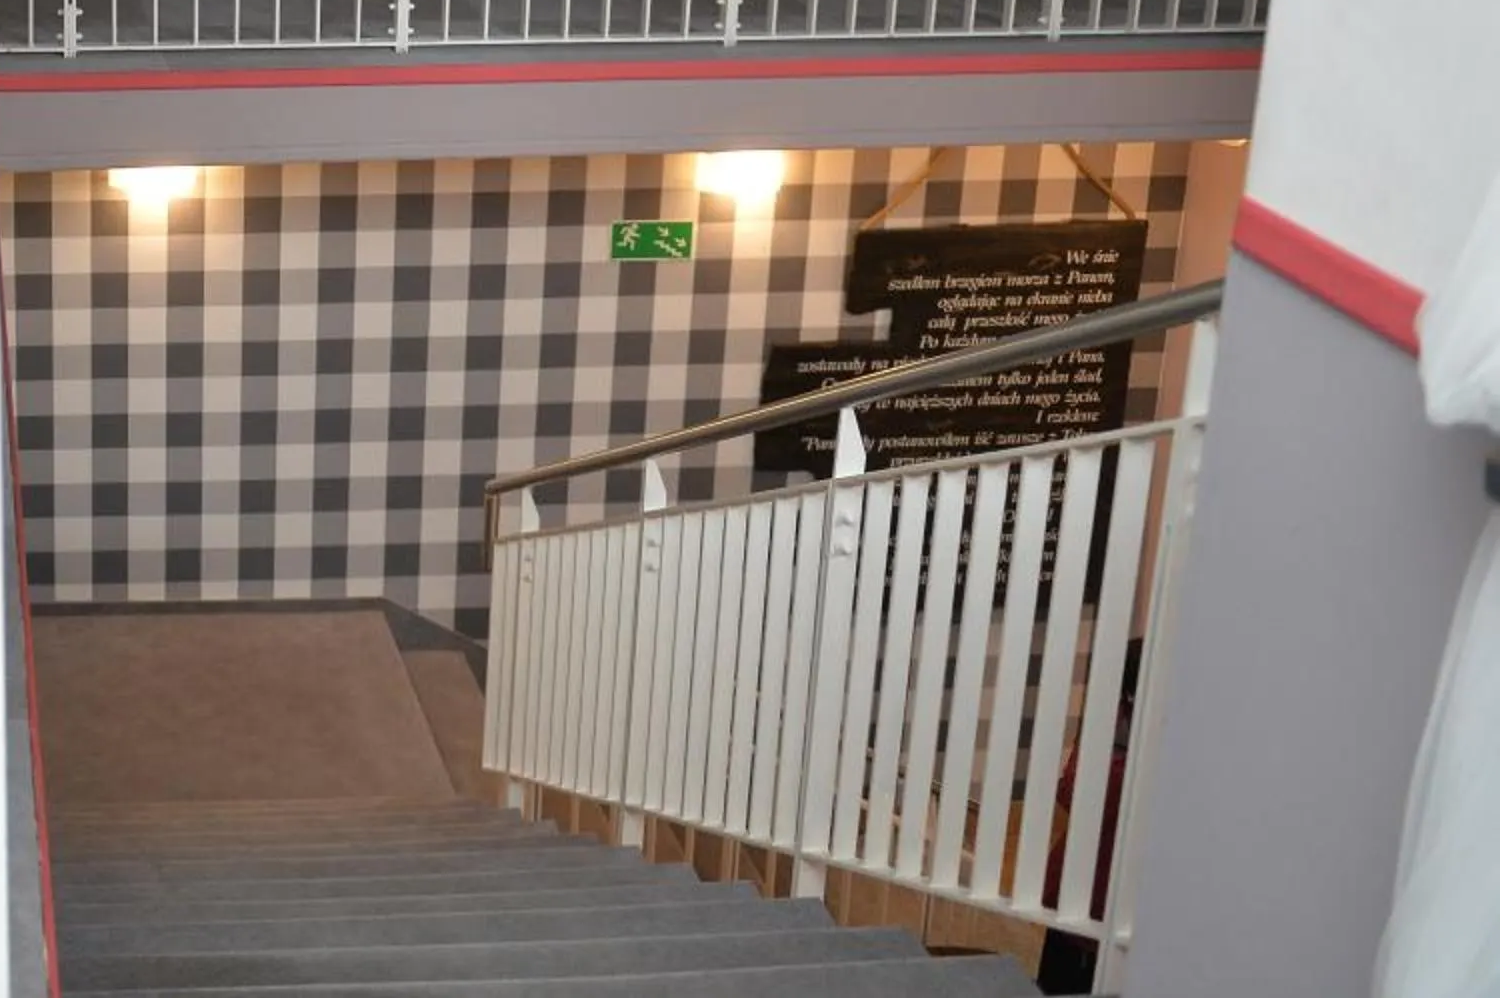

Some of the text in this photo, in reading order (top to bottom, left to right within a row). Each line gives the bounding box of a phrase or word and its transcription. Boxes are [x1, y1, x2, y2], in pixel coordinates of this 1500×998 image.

[1066, 249, 1090, 266] We
[1004, 294, 1023, 306] na
[919, 332, 939, 349] Po
[997, 370, 1032, 389] tylko
